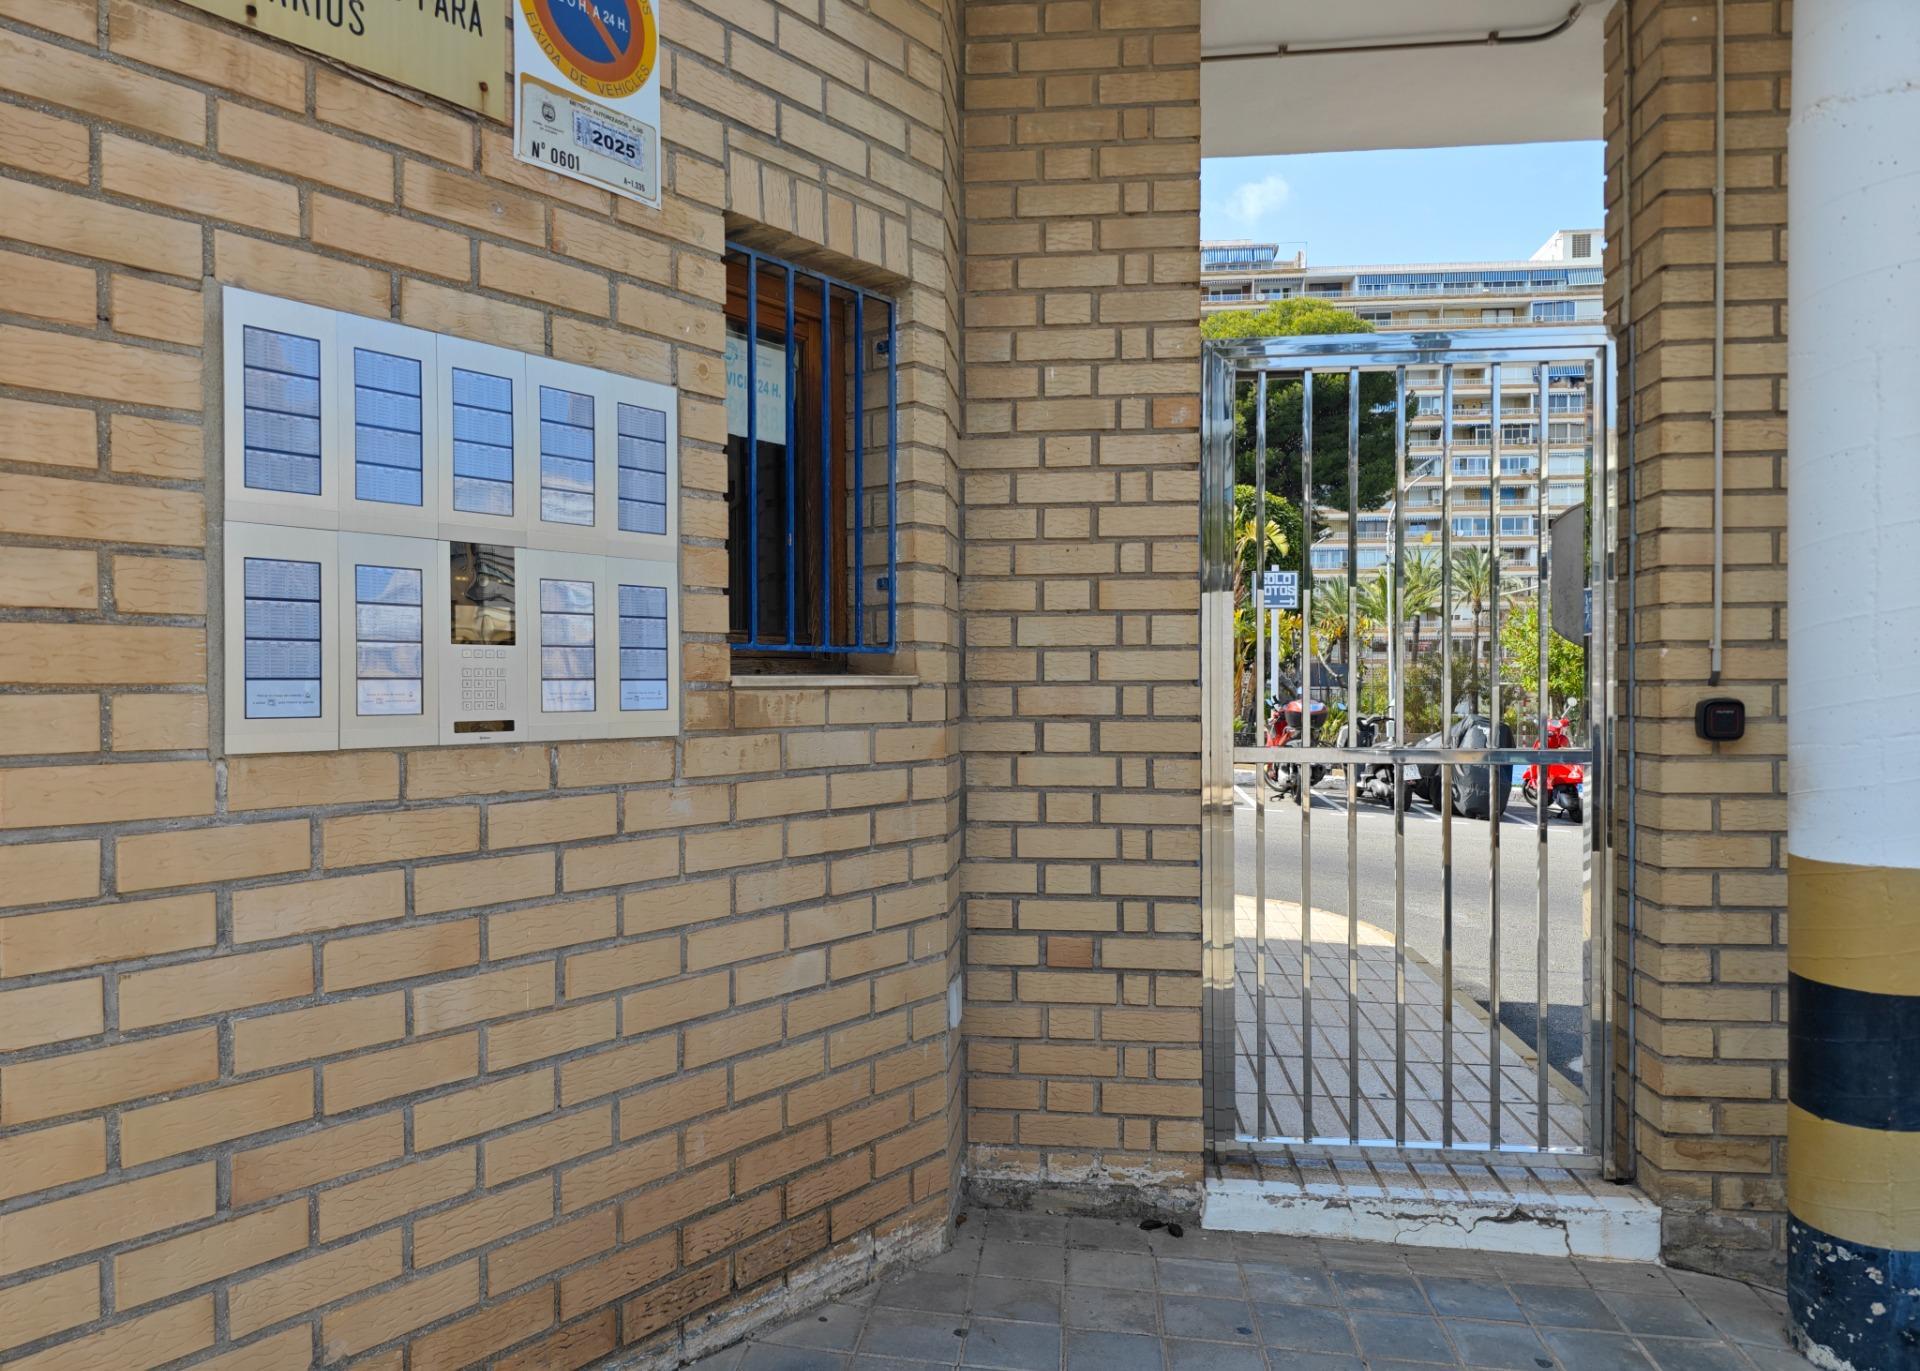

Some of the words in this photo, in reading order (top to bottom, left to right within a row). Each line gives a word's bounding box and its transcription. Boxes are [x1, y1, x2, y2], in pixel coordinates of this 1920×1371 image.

[417, 0, 484, 37] ARA
[592, 10, 601, 20] A
[602, 11, 615, 26] 24
[525, 11, 562, 67] EIXIDA
[570, 68, 588, 88] DE
[597, 63, 650, 96] VEHICLES
[592, 130, 636, 159] 2025
[550, 147, 580, 172] 0601
[1264, 586, 1295, 596] OTOS
